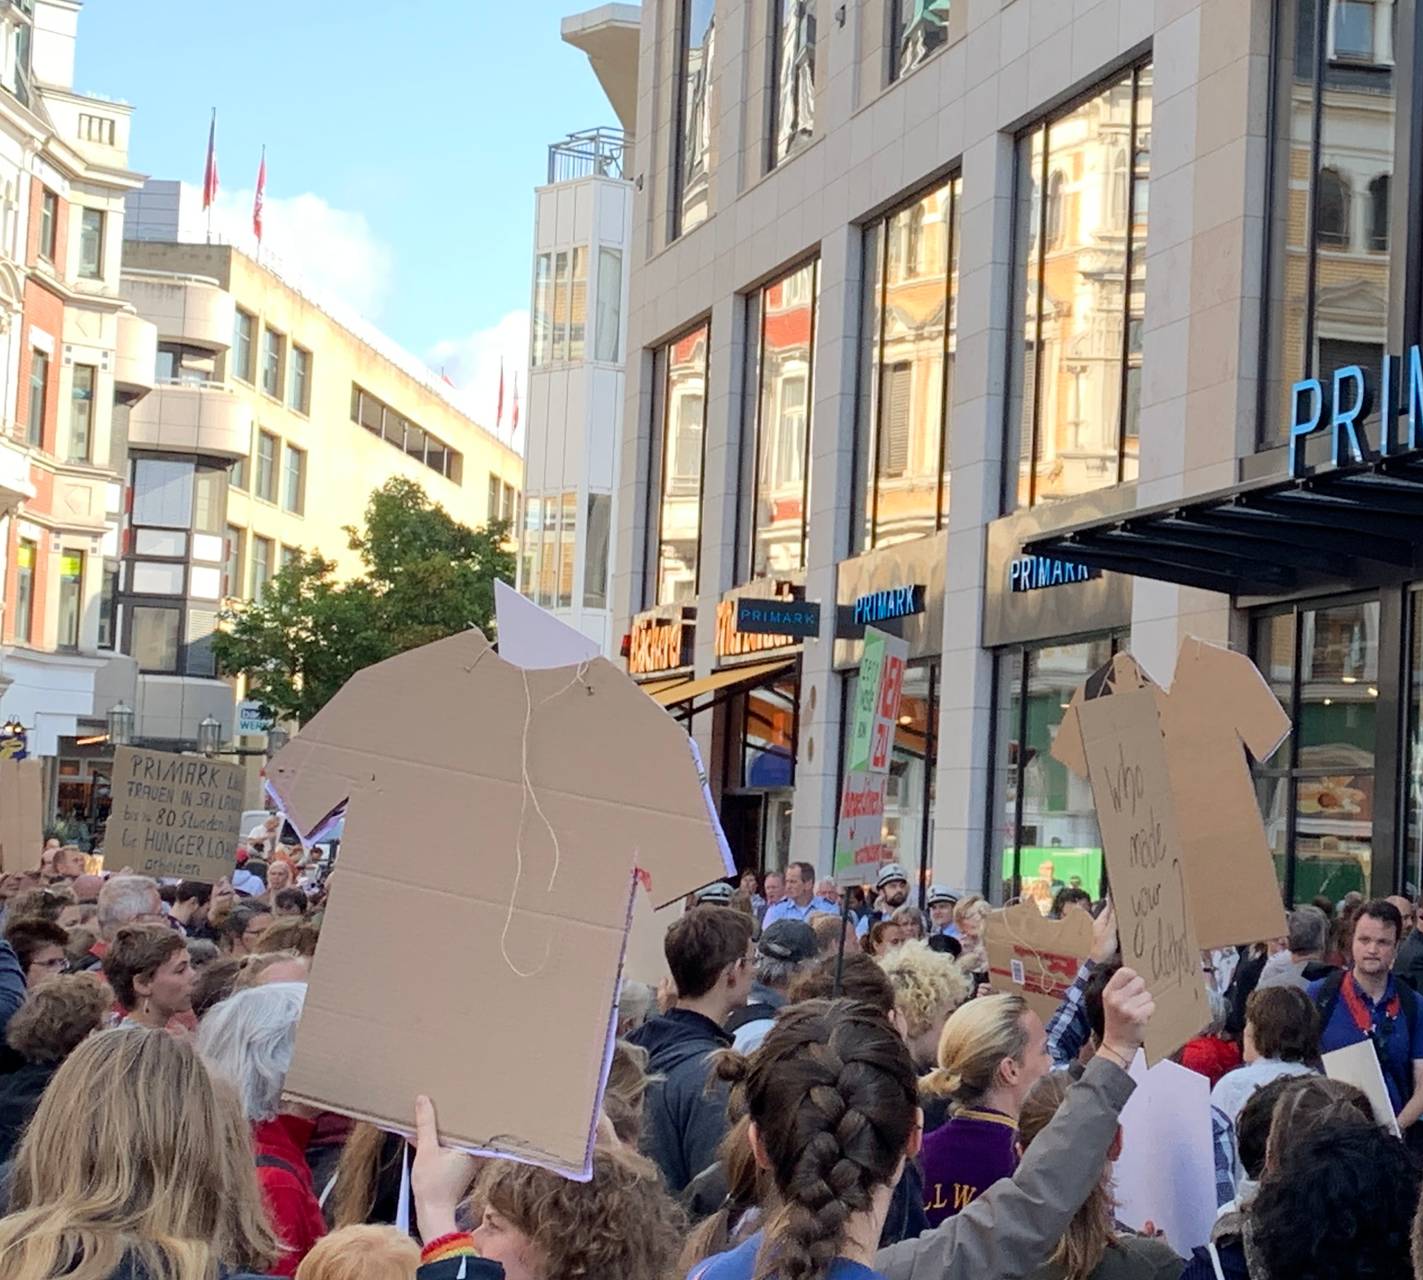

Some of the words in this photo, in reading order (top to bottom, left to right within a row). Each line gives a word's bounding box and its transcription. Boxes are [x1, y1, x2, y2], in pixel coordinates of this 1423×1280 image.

[740, 608, 815, 625] PRIMARK
[854, 584, 915, 624] PRIMARK
[130, 754, 220, 788] PRIMARK
[156, 808, 177, 827] 80
[1130, 806, 1166, 869] made
[1131, 883, 1161, 959] your
